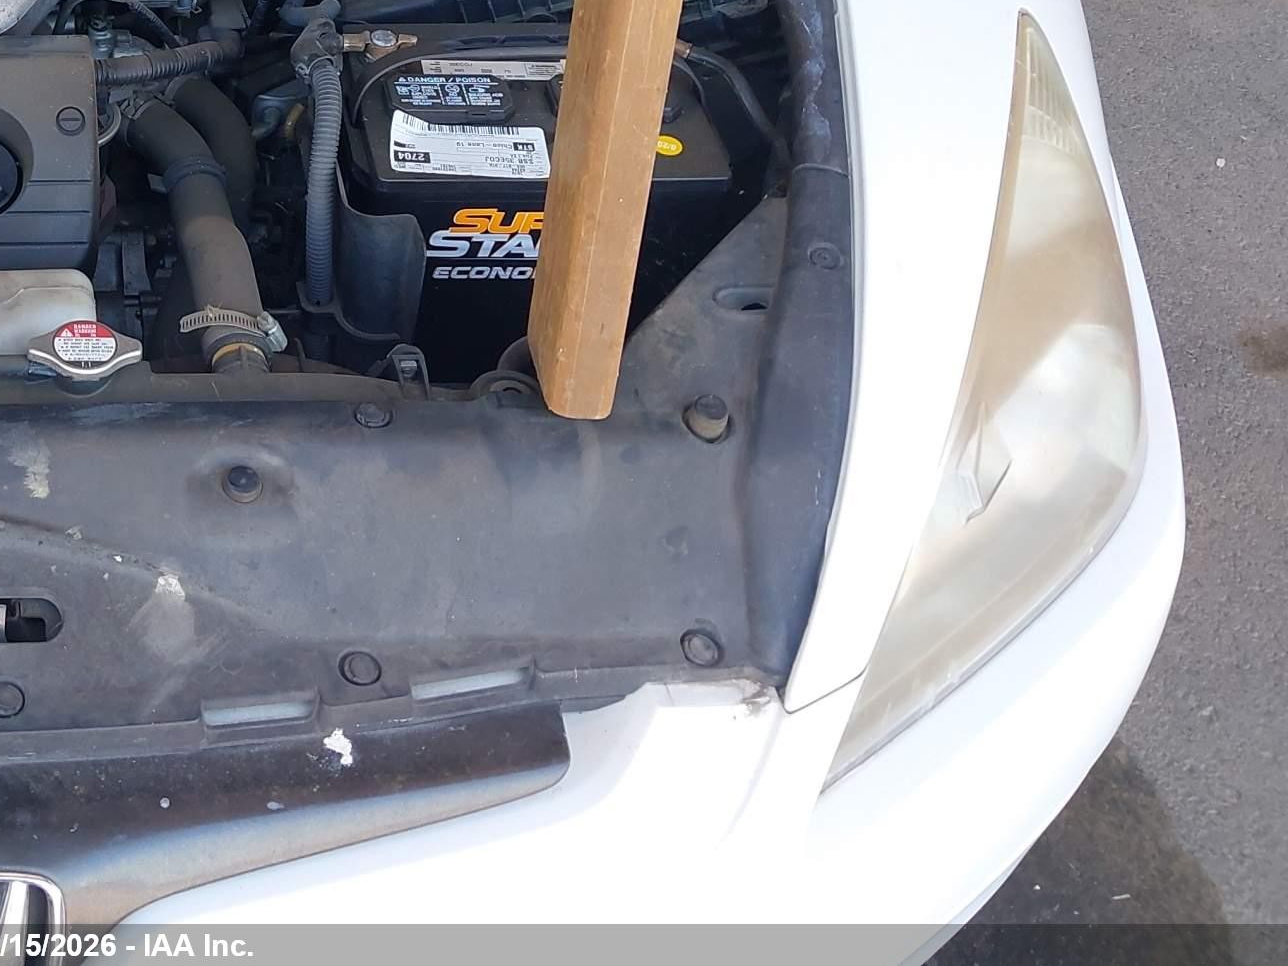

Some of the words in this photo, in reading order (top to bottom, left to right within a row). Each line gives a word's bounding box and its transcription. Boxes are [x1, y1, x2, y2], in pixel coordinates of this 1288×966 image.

[397, 151, 425, 161] 2704
[448, 208, 545, 234] SUP
[426, 230, 542, 257] STA
[432, 266, 537, 279] ECONO
